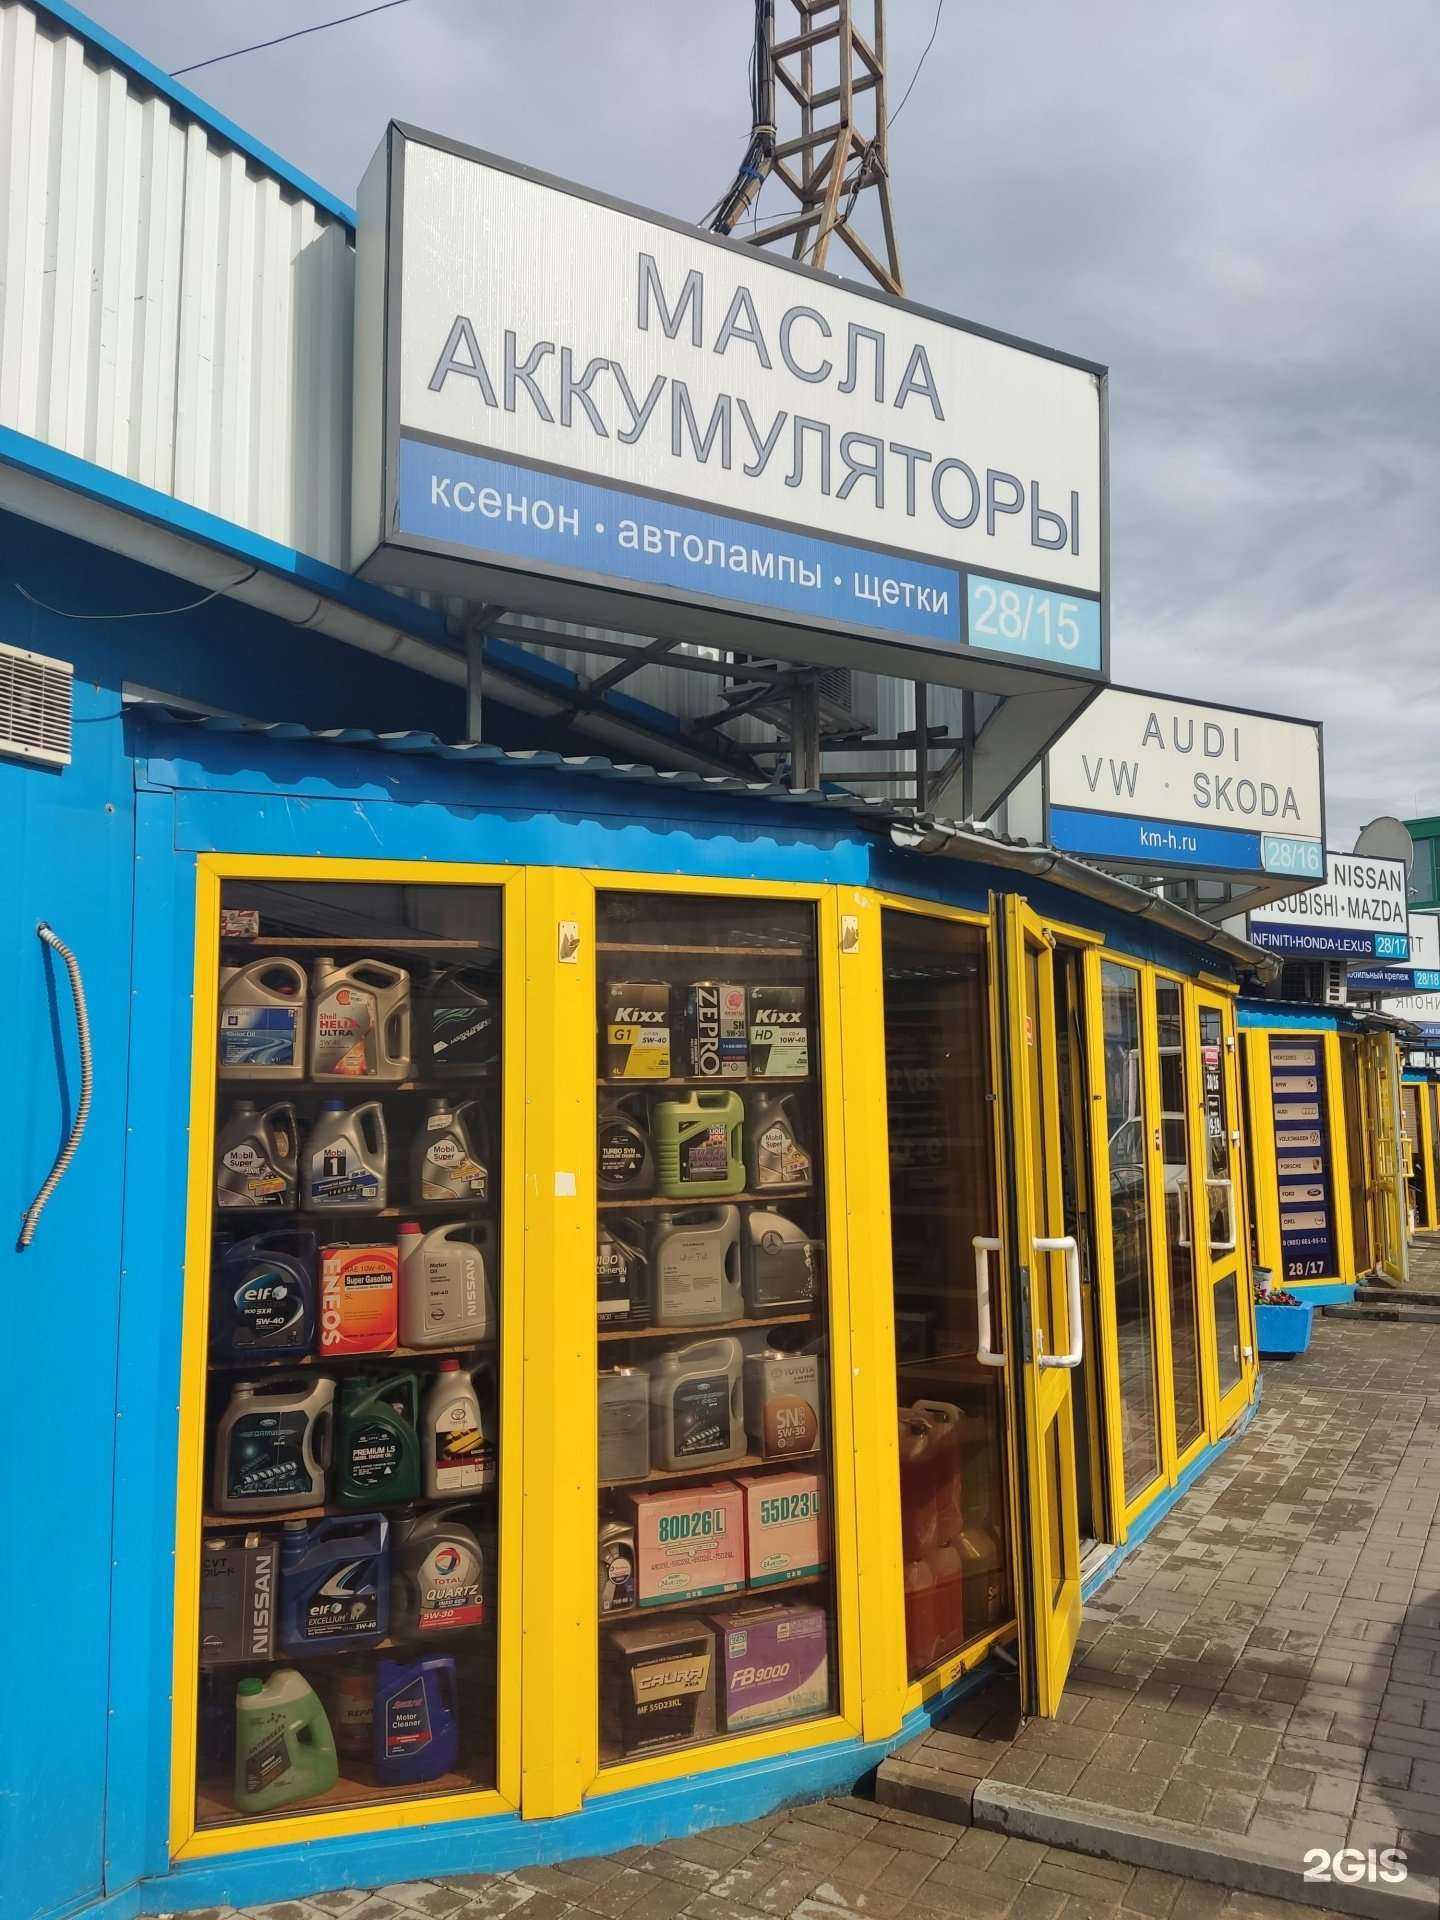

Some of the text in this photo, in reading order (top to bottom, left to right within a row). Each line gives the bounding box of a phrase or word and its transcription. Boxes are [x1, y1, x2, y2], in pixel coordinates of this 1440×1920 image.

[638, 252, 945, 421] МАСЛА
[427, 315, 1080, 556] АККУМУЛЯТОРЫ
[431, 475, 950, 616] ксенон автолампы щетки
[972, 585, 1081, 650] 28/15
[1142, 712, 1239, 762] AUDI
[1082, 755, 1301, 820] VW SKODA
[1140, 827, 1197, 851] km-h.ru
[1269, 841, 1320, 870] 28/16
[1334, 863, 1401, 892] NISSAN
[1348, 897, 1404, 923] MAZDA
[1377, 937, 1408, 955] 28/17
[615, 1007, 666, 1023] Kixx
[755, 1009, 802, 1024] Kixx
[320, 1029, 353, 1037] ULTRA
[614, 1029, 632, 1041] G1
[699, 988, 720, 1075] ZEPRO
[755, 1029, 773, 1040] HD
[346, 1275, 364, 1285] Super
[465, 1258, 478, 1317] NISSAN
[244, 1287, 272, 1301] elf
[322, 1259, 341, 1346] ENEOS
[776, 1407, 799, 1429] SN
[777, 1426, 806, 1439] 5W-30
[252, 1555, 272, 1654] NISSAN
[426, 1584, 479, 1601] QUARTZ
[310, 1604, 330, 1616] elf
